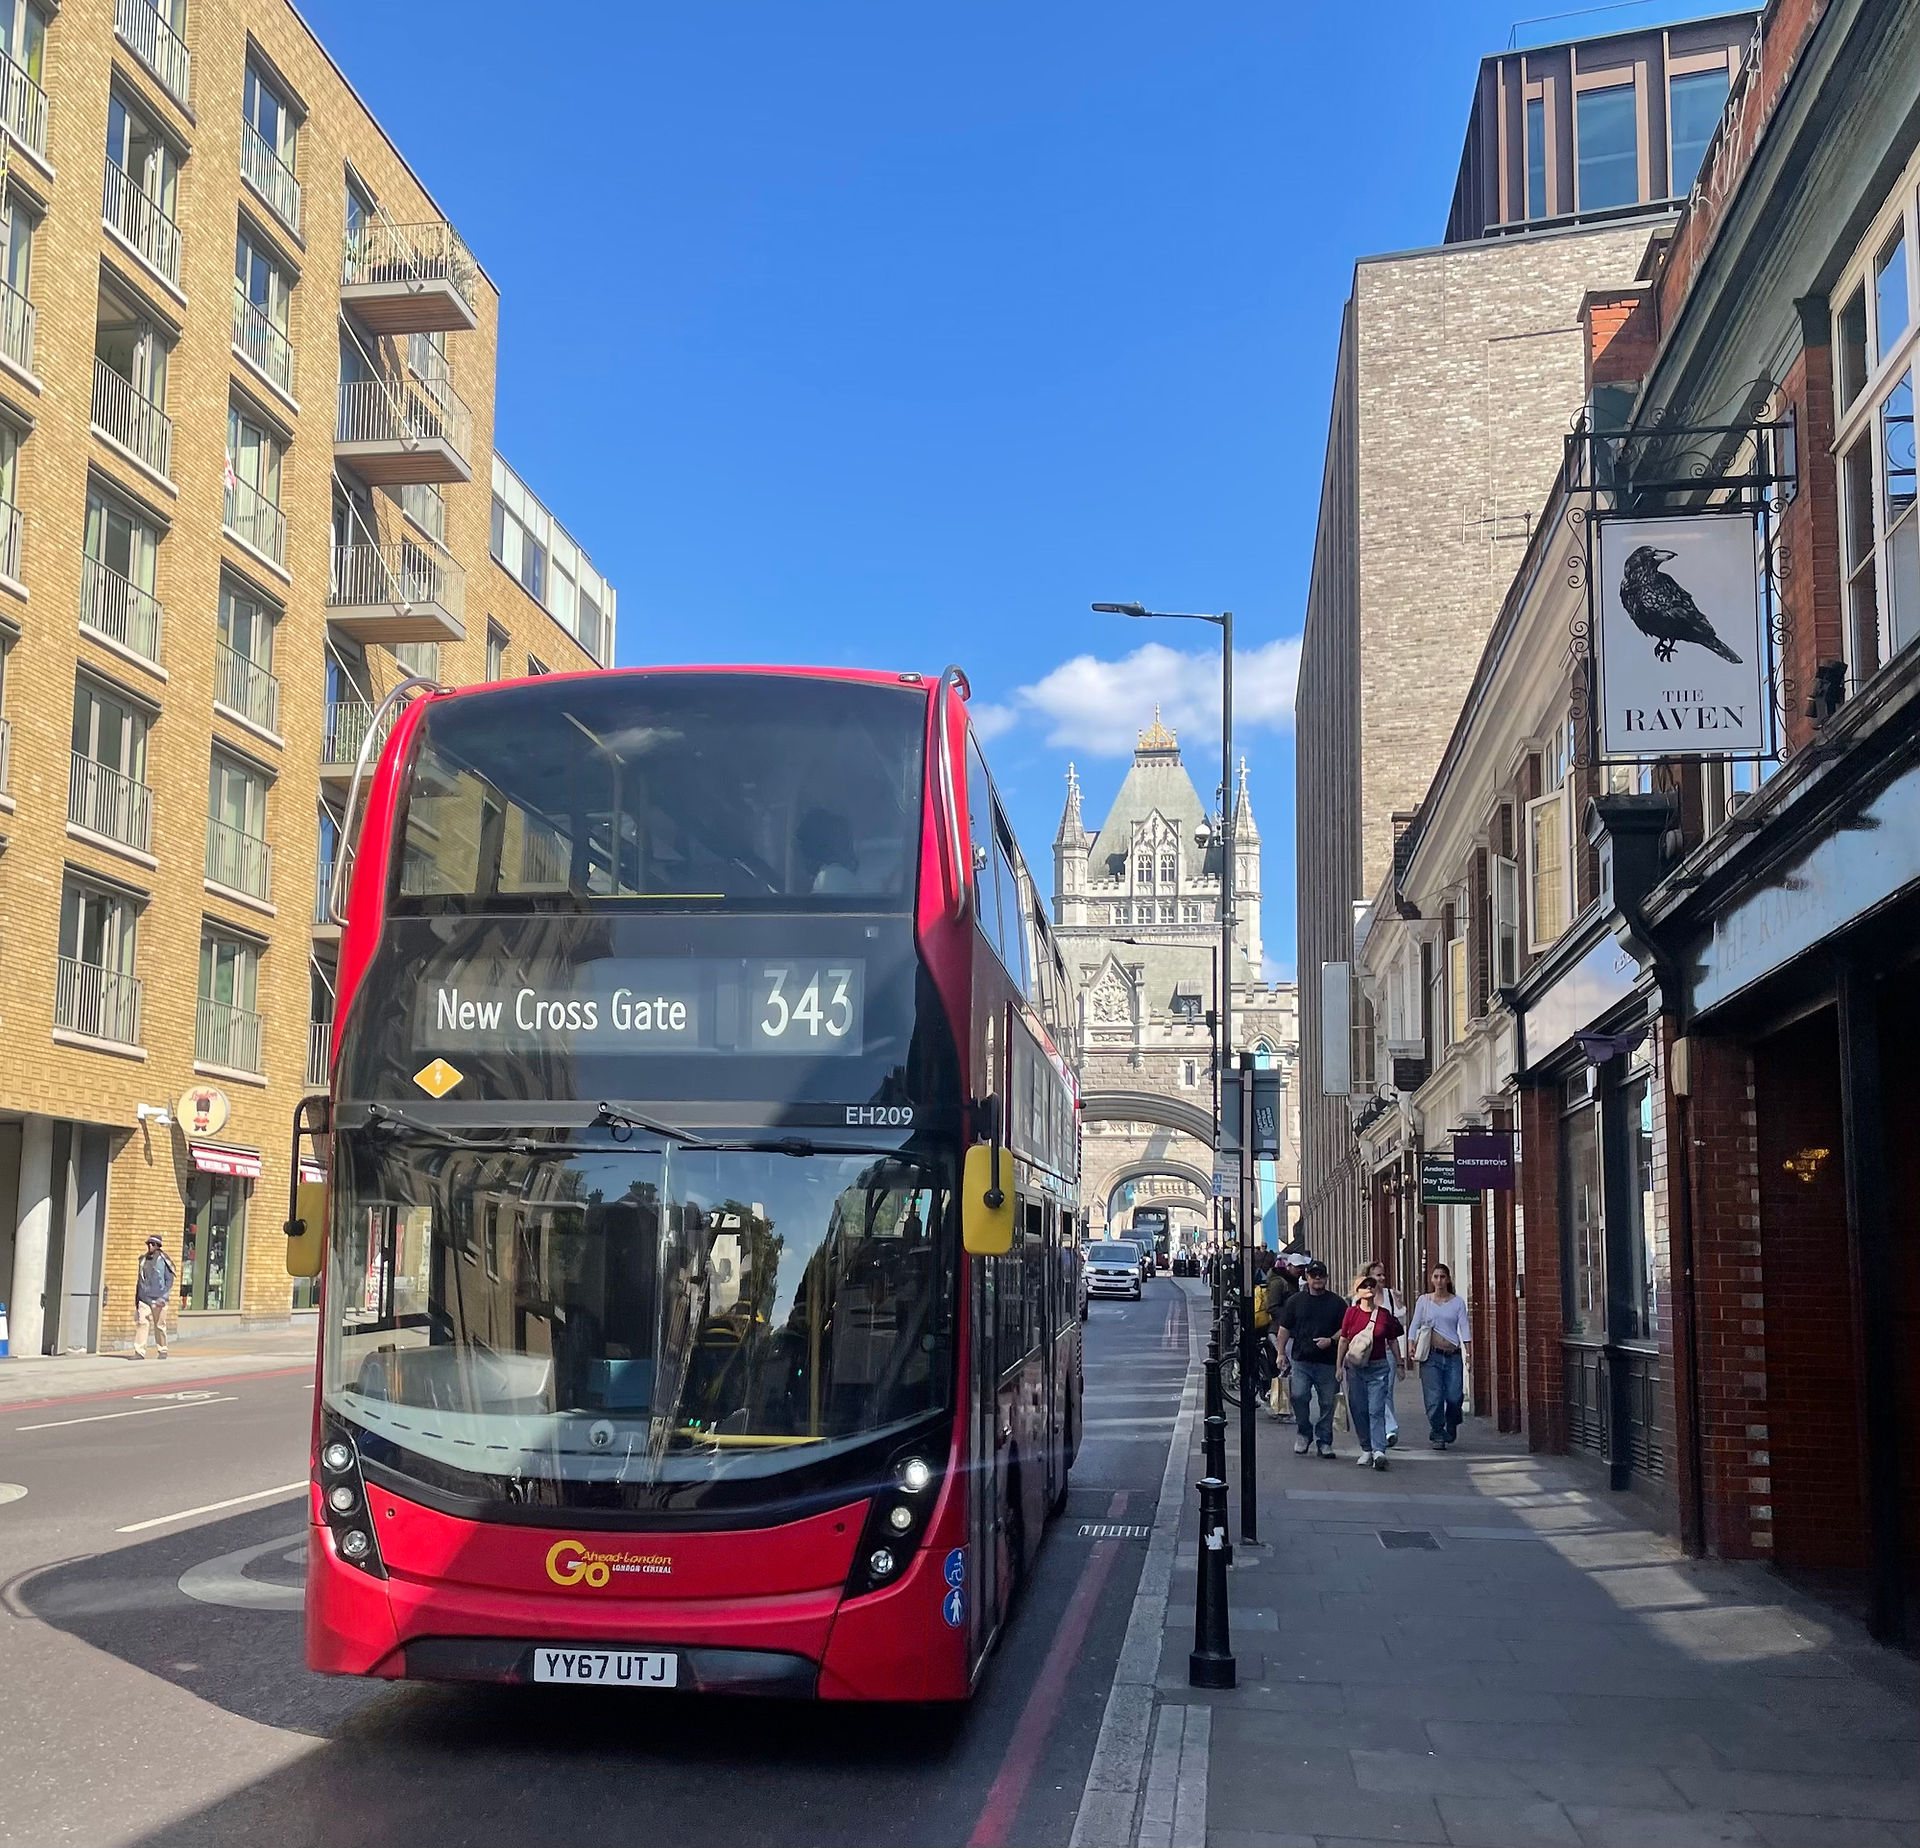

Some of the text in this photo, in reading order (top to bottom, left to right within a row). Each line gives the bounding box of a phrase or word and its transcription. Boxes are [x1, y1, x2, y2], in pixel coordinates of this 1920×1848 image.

[1662, 689, 1704, 703] THE
[1623, 705, 1746, 731] RAVEN
[437, 988, 687, 1031] New Cross Gate
[761, 969, 854, 1037] 343
[845, 1106, 914, 1126] EH209
[1456, 1158, 1508, 1167] CHESTERTONS
[546, 1540, 672, 1588] Go Ahead-London
[612, 1564, 672, 1574] LONDON CENTRAL
[546, 1653, 666, 1681] YY67 UTJ
